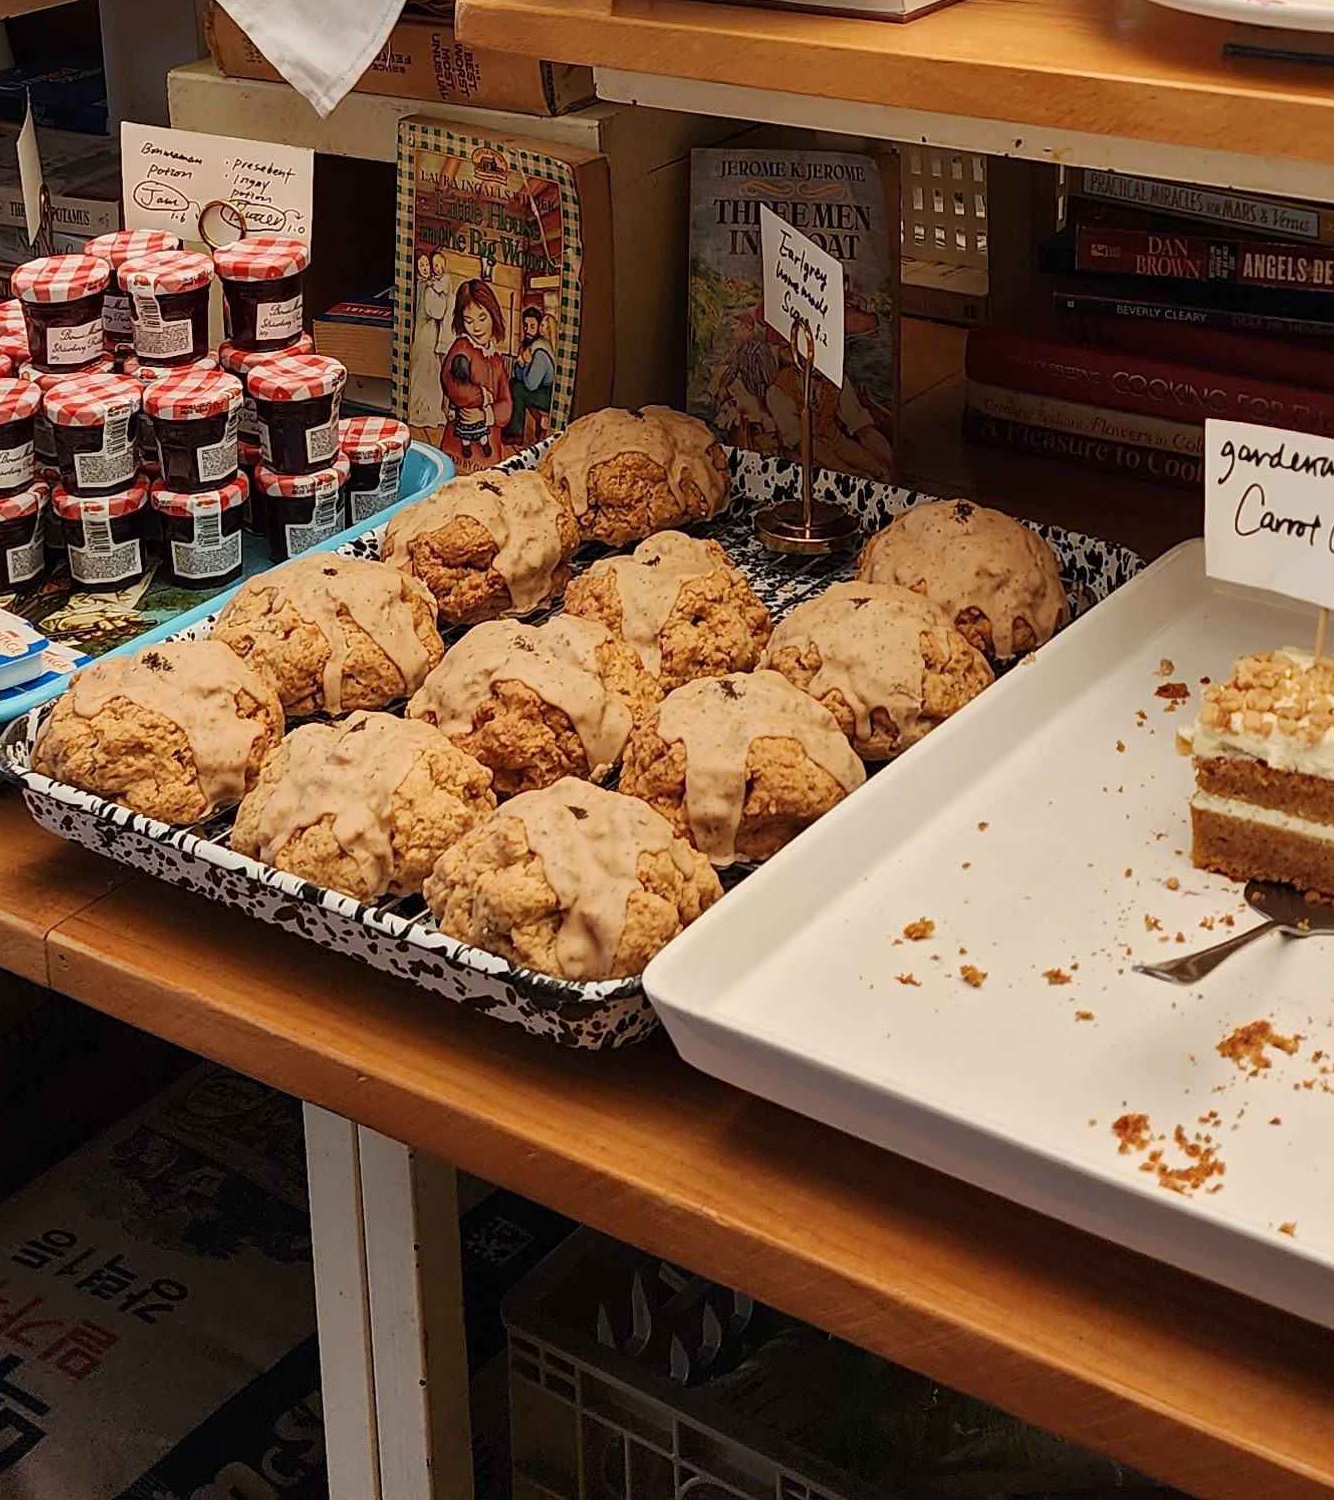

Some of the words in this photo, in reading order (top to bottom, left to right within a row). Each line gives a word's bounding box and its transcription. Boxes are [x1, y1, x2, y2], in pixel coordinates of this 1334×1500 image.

[421, 170, 459, 189] LAURA
[462, 180, 510, 200] INGALLS
[720, 160, 786, 177] JEROME
[805, 163, 865, 182] JEROME
[1090, 172, 1146, 202] PRACTICAL
[1150, 186, 1204, 213] MIRACLES
[1222, 200, 1256, 224] MARS
[812, 202, 872, 231] MEN
[1148, 236, 1189, 256] DAN
[1135, 255, 1201, 279] BROWN
[1242, 253, 1308, 283] ANGELS
[1116, 304, 1161, 318] BEVERLY
[1164, 309, 1208, 323] CLEARY
[1111, 370, 1228, 414] COOKING
[1006, 420, 1108, 462] Pleasure
[1115, 440, 1141, 468] to
[1086, 415, 1151, 445] Flowers
[1235, 483, 1321, 546] Carrot
